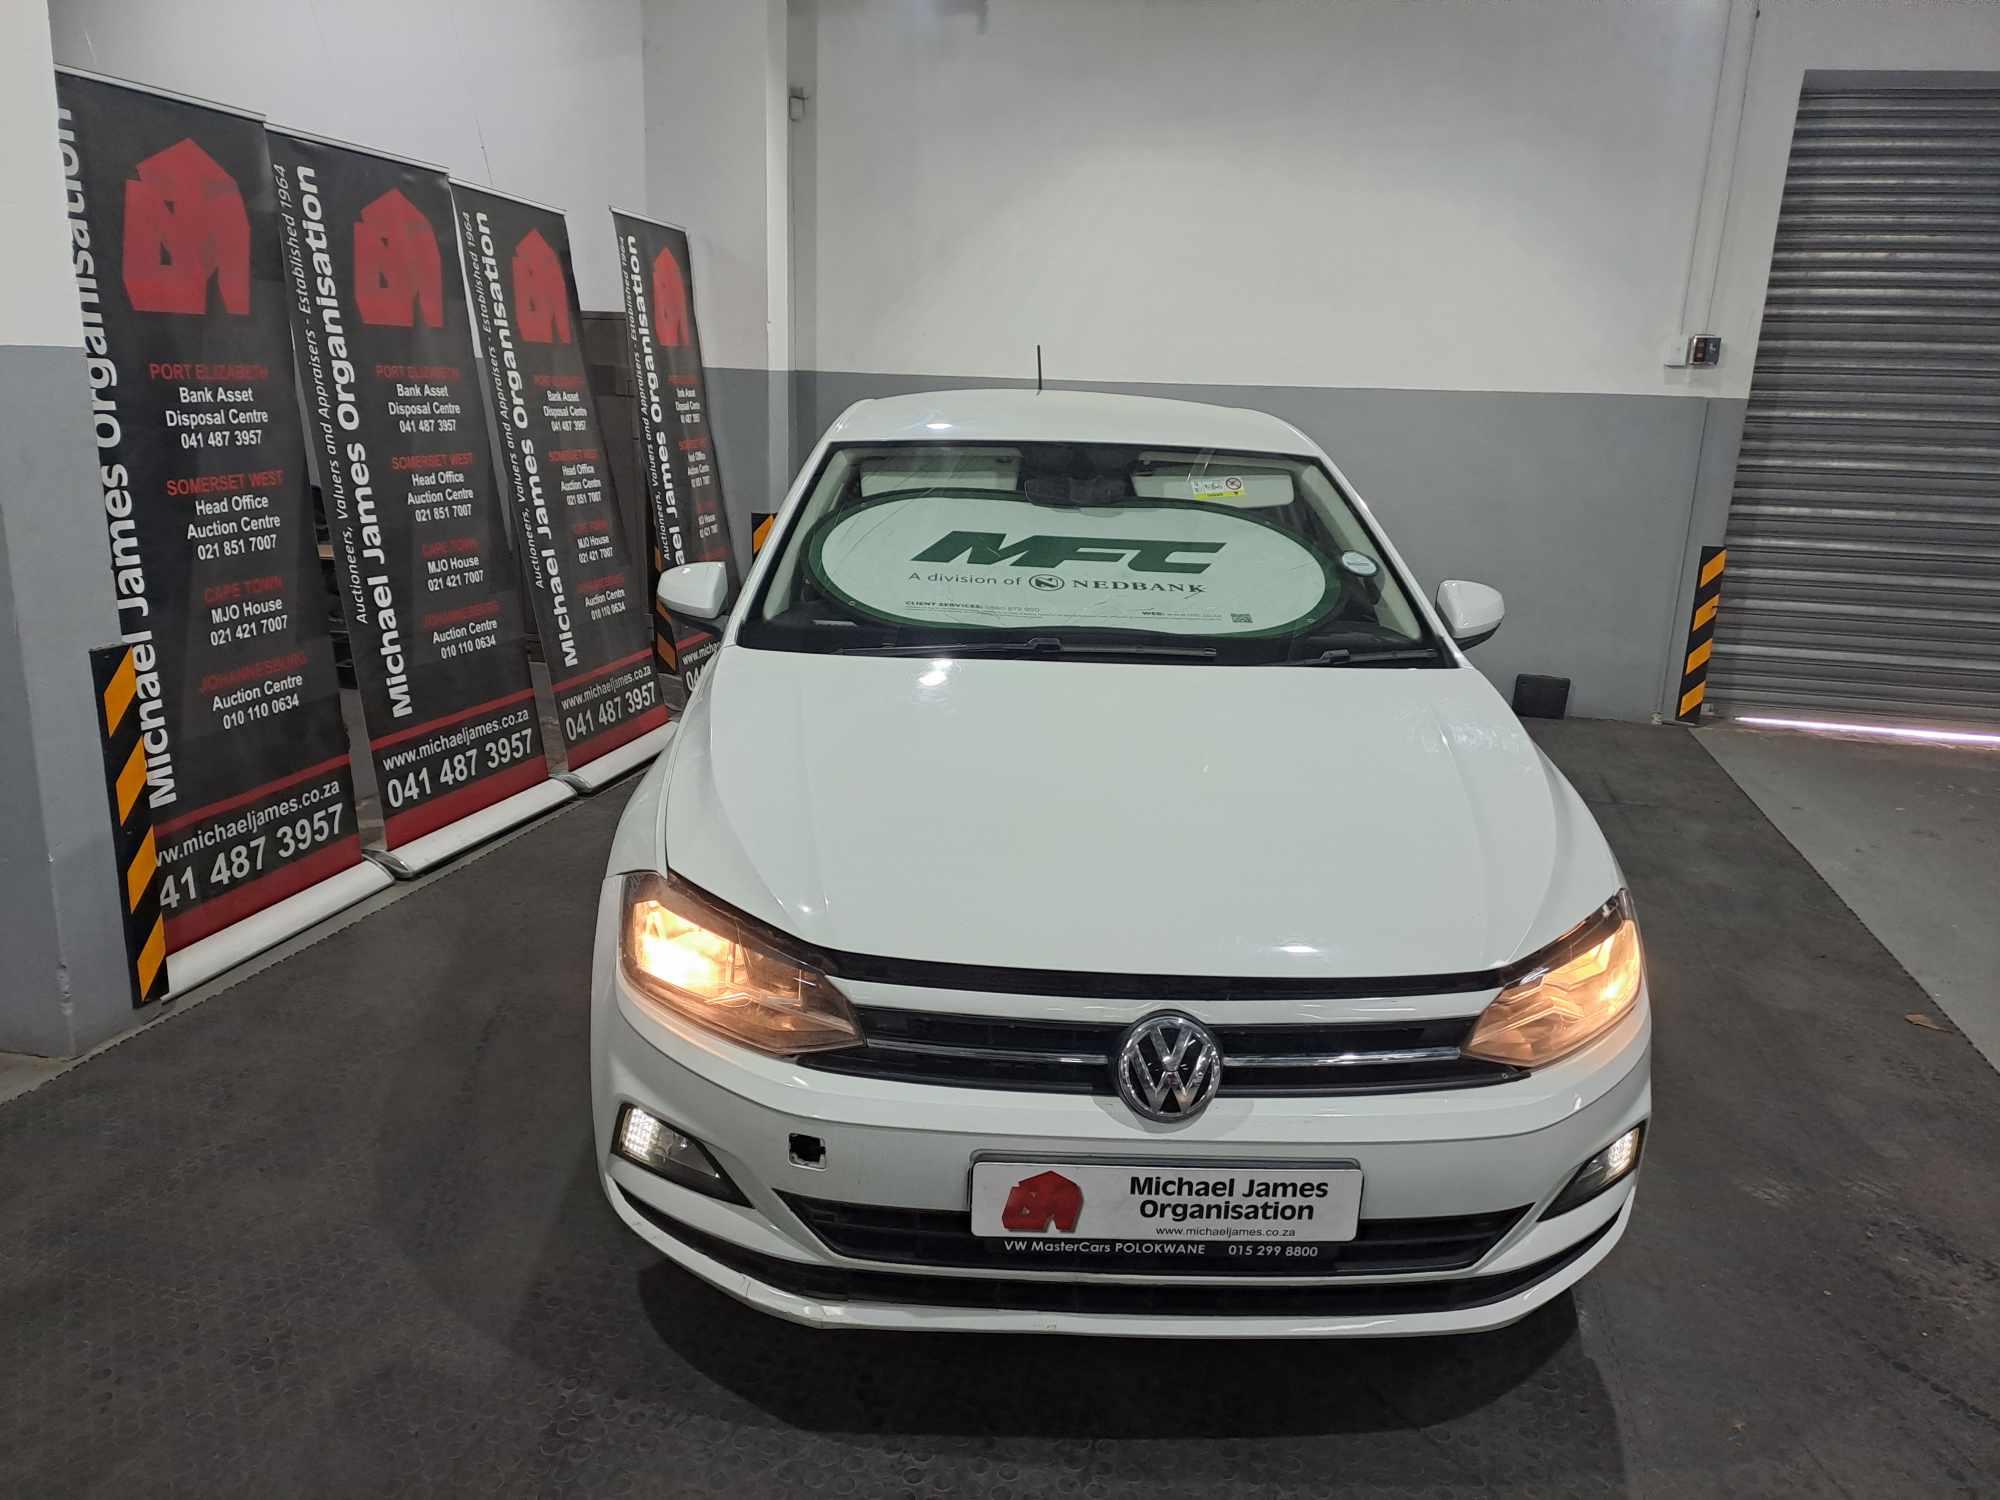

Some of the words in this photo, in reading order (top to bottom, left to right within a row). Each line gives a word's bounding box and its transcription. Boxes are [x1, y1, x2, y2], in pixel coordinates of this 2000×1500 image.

[273, 164, 292, 208] 1964
[282, 213, 311, 314] Established
[297, 166, 359, 431] Organisation
[469, 251, 491, 333] Established
[476, 212, 528, 429] Organisation
[628, 236, 662, 423] Organisation
[149, 363, 195, 380] PORT
[306, 329, 330, 419] Appraisers
[396, 383, 421, 397] Bank
[424, 383, 449, 397] Asset
[488, 346, 509, 420] Appraisers
[179, 387, 214, 403] Bank
[216, 386, 254, 402] Asset
[388, 402, 431, 417] Disposal
[432, 402, 461, 415] Centre
[165, 409, 226, 429] Disposal
[228, 408, 269, 424] Centre
[399, 420, 417, 433] 041
[418, 419, 435, 432] 487
[438, 419, 457, 432] 3957
[504, 424, 516, 449] and
[180, 432, 204, 449] 041
[207, 431, 230, 447] 487
[234, 429, 262, 446] 3957
[324, 421, 337, 454] and
[166, 474, 246, 496] SOMERSET
[248, 469, 283, 488] WEST
[329, 460, 349, 519] Valuers
[411, 473, 436, 487] Head
[437, 470, 465, 484] Office
[510, 451, 526, 502] Valuers
[521, 439, 552, 540] James
[656, 431, 678, 518] James
[195, 498, 228, 516] Head
[231, 494, 269, 511] Office
[347, 442, 384, 564] James
[407, 490, 444, 506] Auction
[445, 487, 474, 501] Centre
[415, 508, 432, 522] 021
[433, 506, 450, 520] 851
[452, 504, 472, 517] 7007
[101, 463, 148, 616] James
[187, 520, 238, 540] Auction
[240, 514, 281, 532] Centre
[197, 542, 220, 561] 021
[223, 539, 245, 556] 851
[249, 534, 277, 552] 7007
[427, 559, 449, 574] MJO
[450, 556, 480, 570] House
[522, 508, 544, 589] Auctioneers,
[910, 530, 1227, 574] MFC
[342, 526, 368, 624] Auctioneers,
[427, 578, 444, 592] 021
[445, 575, 462, 588] 421
[463, 570, 484, 585] 7007
[908, 572, 921, 581] A
[927, 573, 998, 585] division
[1003, 575, 1023, 586] of
[1071, 579, 1207, 593] NEDBANK
[211, 604, 240, 624] MJO
[242, 598, 283, 617] House
[541, 548, 578, 667] Michael
[210, 627, 232, 646] 021
[235, 622, 257, 640] 421
[260, 614, 288, 634] 7007
[367, 576, 413, 718] Michael
[432, 626, 468, 644] Auction
[468, 619, 498, 635] Centre
[440, 644, 457, 660] 010
[458, 640, 474, 654] 110
[475, 634, 497, 651] 0634
[212, 687, 261, 711] Auction
[263, 674, 303, 696] Centre
[561, 665, 652, 711] www.michaeljames.co.za
[121, 630, 177, 809] Michael
[222, 710, 245, 730] 010
[247, 702, 269, 721] 110
[271, 693, 300, 714] 0634
[565, 709, 594, 741] 041
[598, 696, 622, 726] 487
[625, 681, 656, 713] 3957
[382, 709, 529, 771] www.michaeljames.co.za
[387, 767, 432, 808] 041
[439, 748, 478, 785] 487
[485, 727, 532, 769] 3957
[157, 780, 340, 867] w.michaeljames.co.za
[209, 835, 266, 885] 487
[275, 802, 344, 858] 3957
[1129, 1176, 1236, 1197] Michael
[1241, 1178, 1329, 1199] James
[1139, 1200, 1315, 1222] Organisation
[1003, 1240, 1028, 1252] VW
[1031, 1240, 1111, 1253] MasterCars
[1114, 1241, 1206, 1256] POLOKWANE
[1228, 1244, 1253, 1256] 015
[1256, 1245, 1281, 1257] 299
[1285, 1246, 1318, 1258] 8800
[1155, 1227, 1296, 1238] www.michaeljames.co.za
